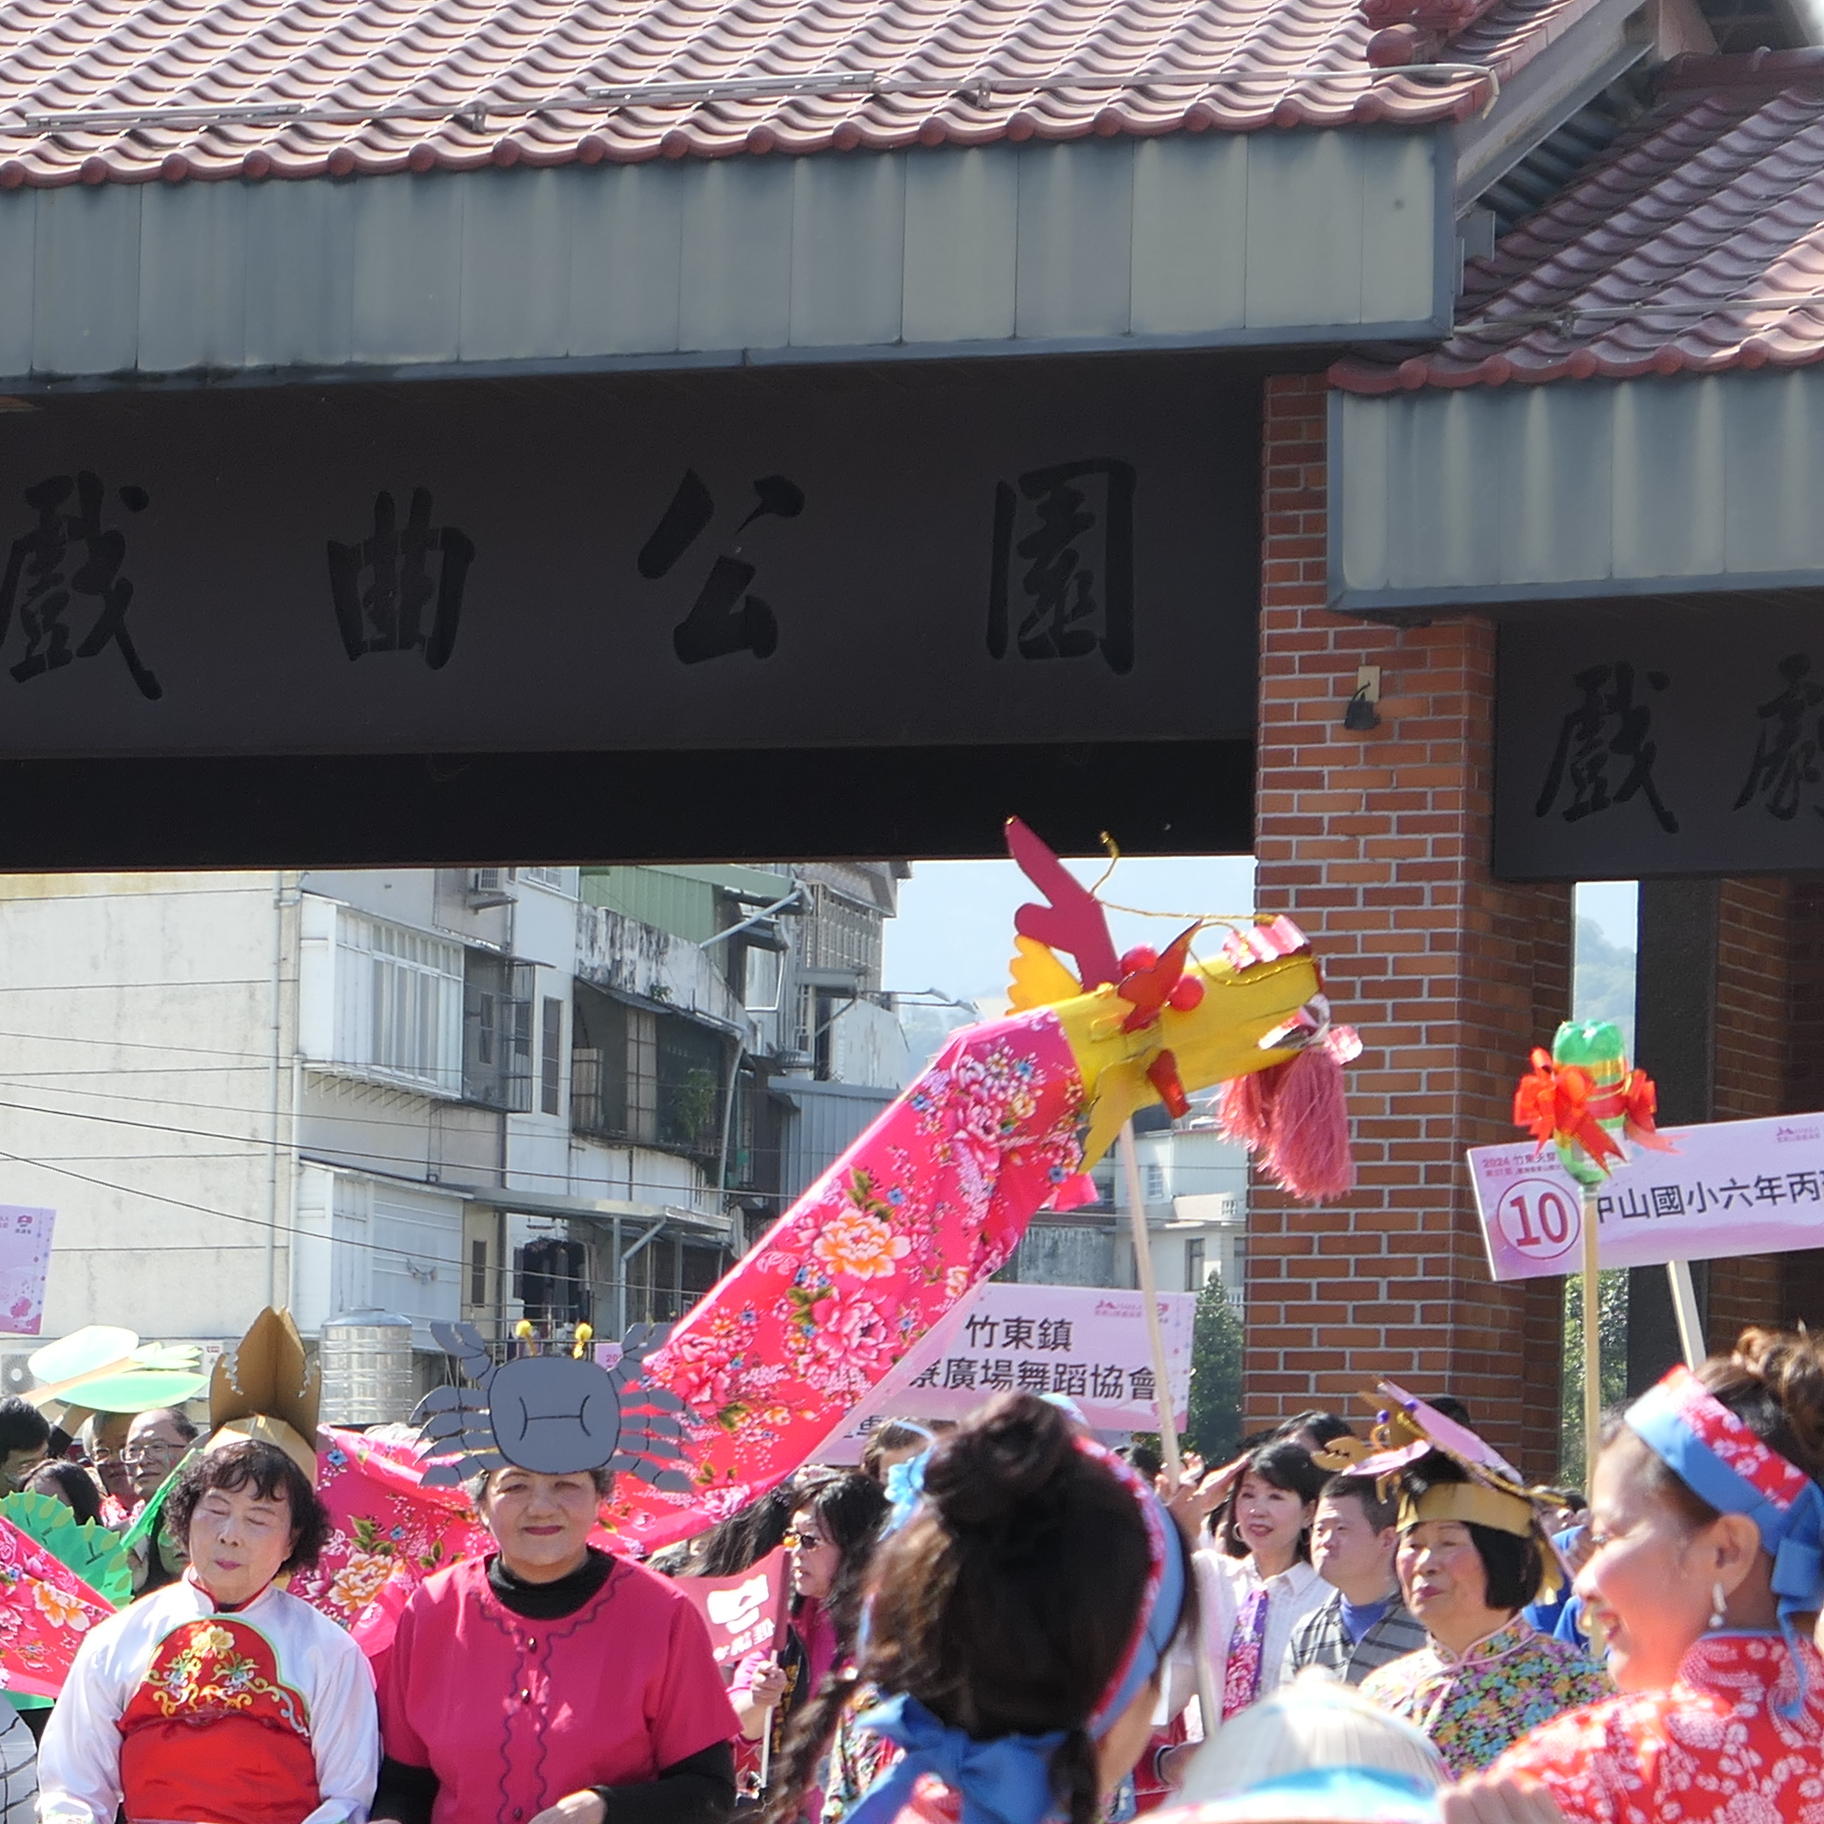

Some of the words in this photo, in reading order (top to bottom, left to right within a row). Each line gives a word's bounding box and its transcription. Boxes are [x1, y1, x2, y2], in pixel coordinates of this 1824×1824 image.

[1508, 1191, 1569, 1248] 10
[1597, 1168, 1824, 1224] 中山國小六年丙
[965, 1314, 1073, 1353] 竹東鎮
